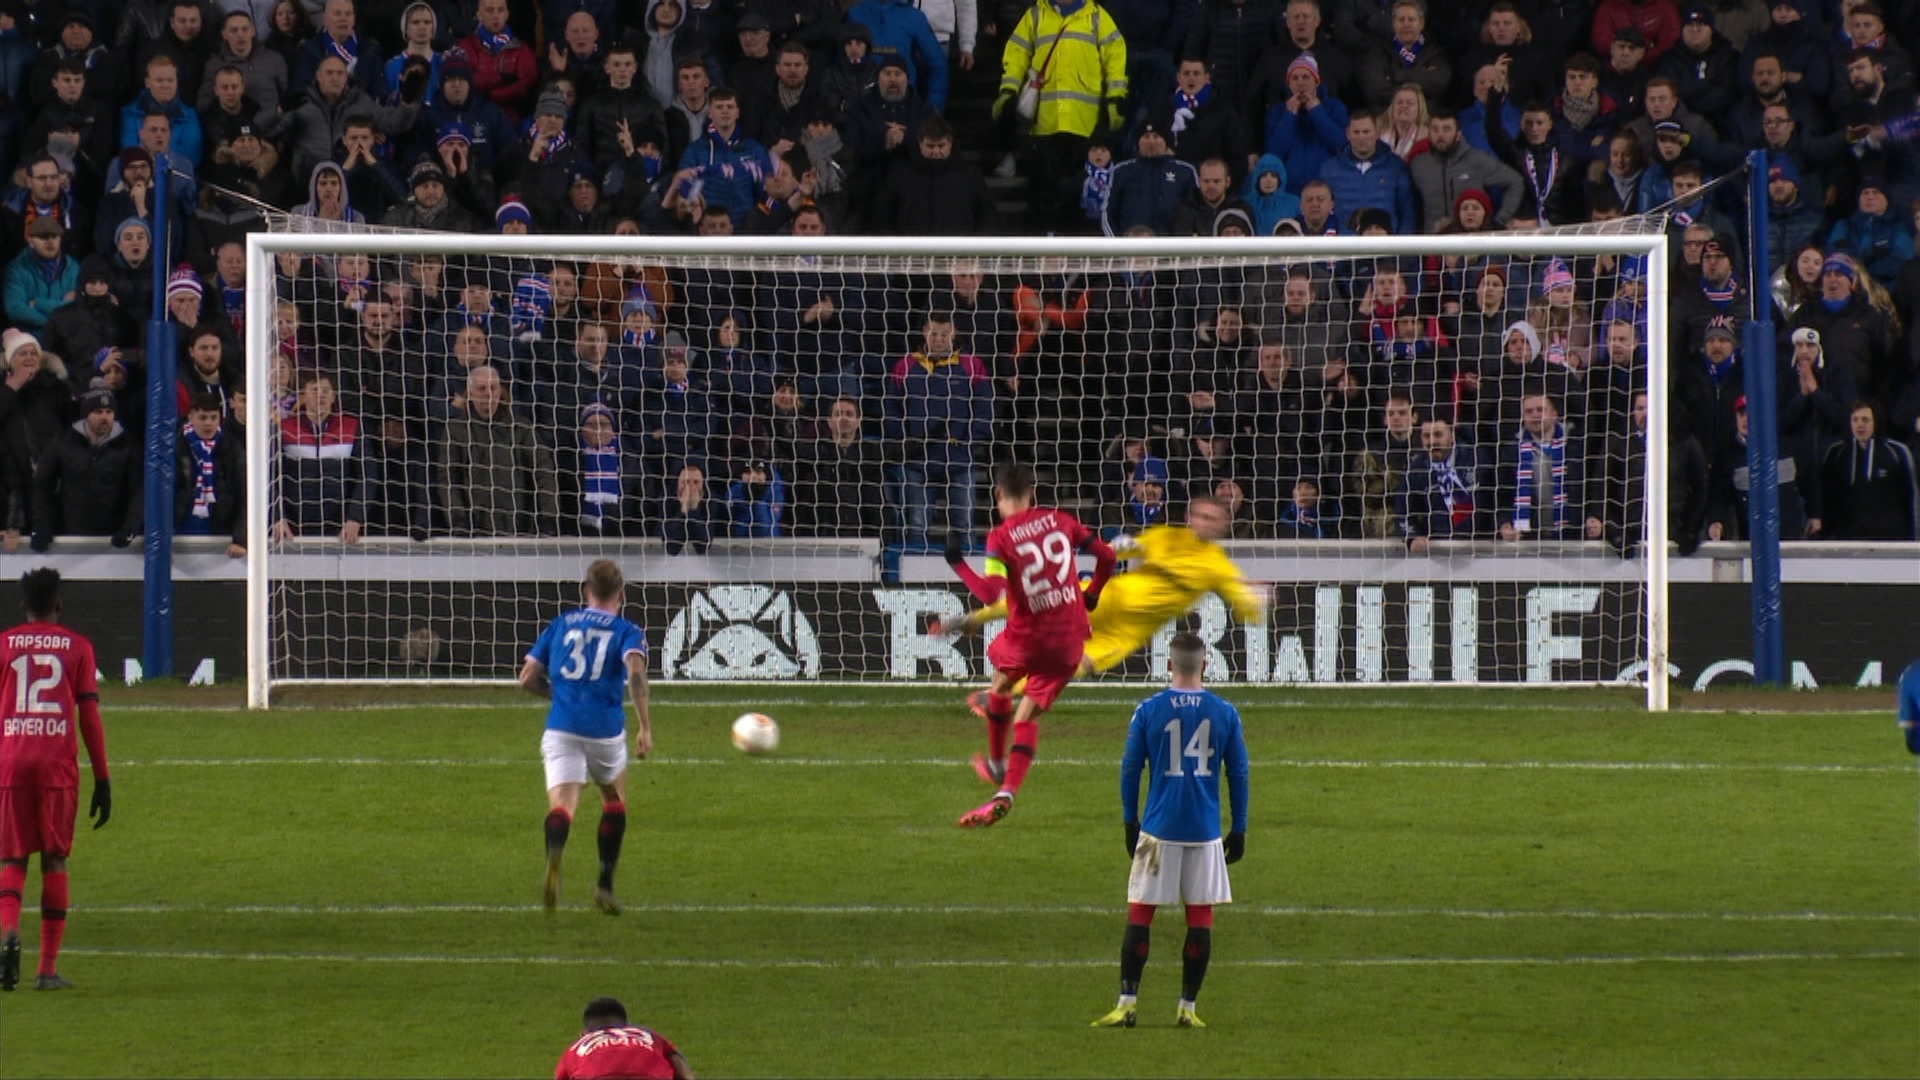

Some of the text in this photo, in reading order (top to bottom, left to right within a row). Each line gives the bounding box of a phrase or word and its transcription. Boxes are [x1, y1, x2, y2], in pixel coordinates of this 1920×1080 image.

[1009, 514, 1057, 542] HAVERTZ
[1015, 531, 1071, 596] 29
[8, 635, 70, 650] TAPSOBA
[560, 628, 615, 681] 37
[10, 654, 62, 713] 12
[1170, 694, 1202, 709] KENT
[4, 718, 67, 737] BAYER 04
[1163, 717, 1215, 777] 14
